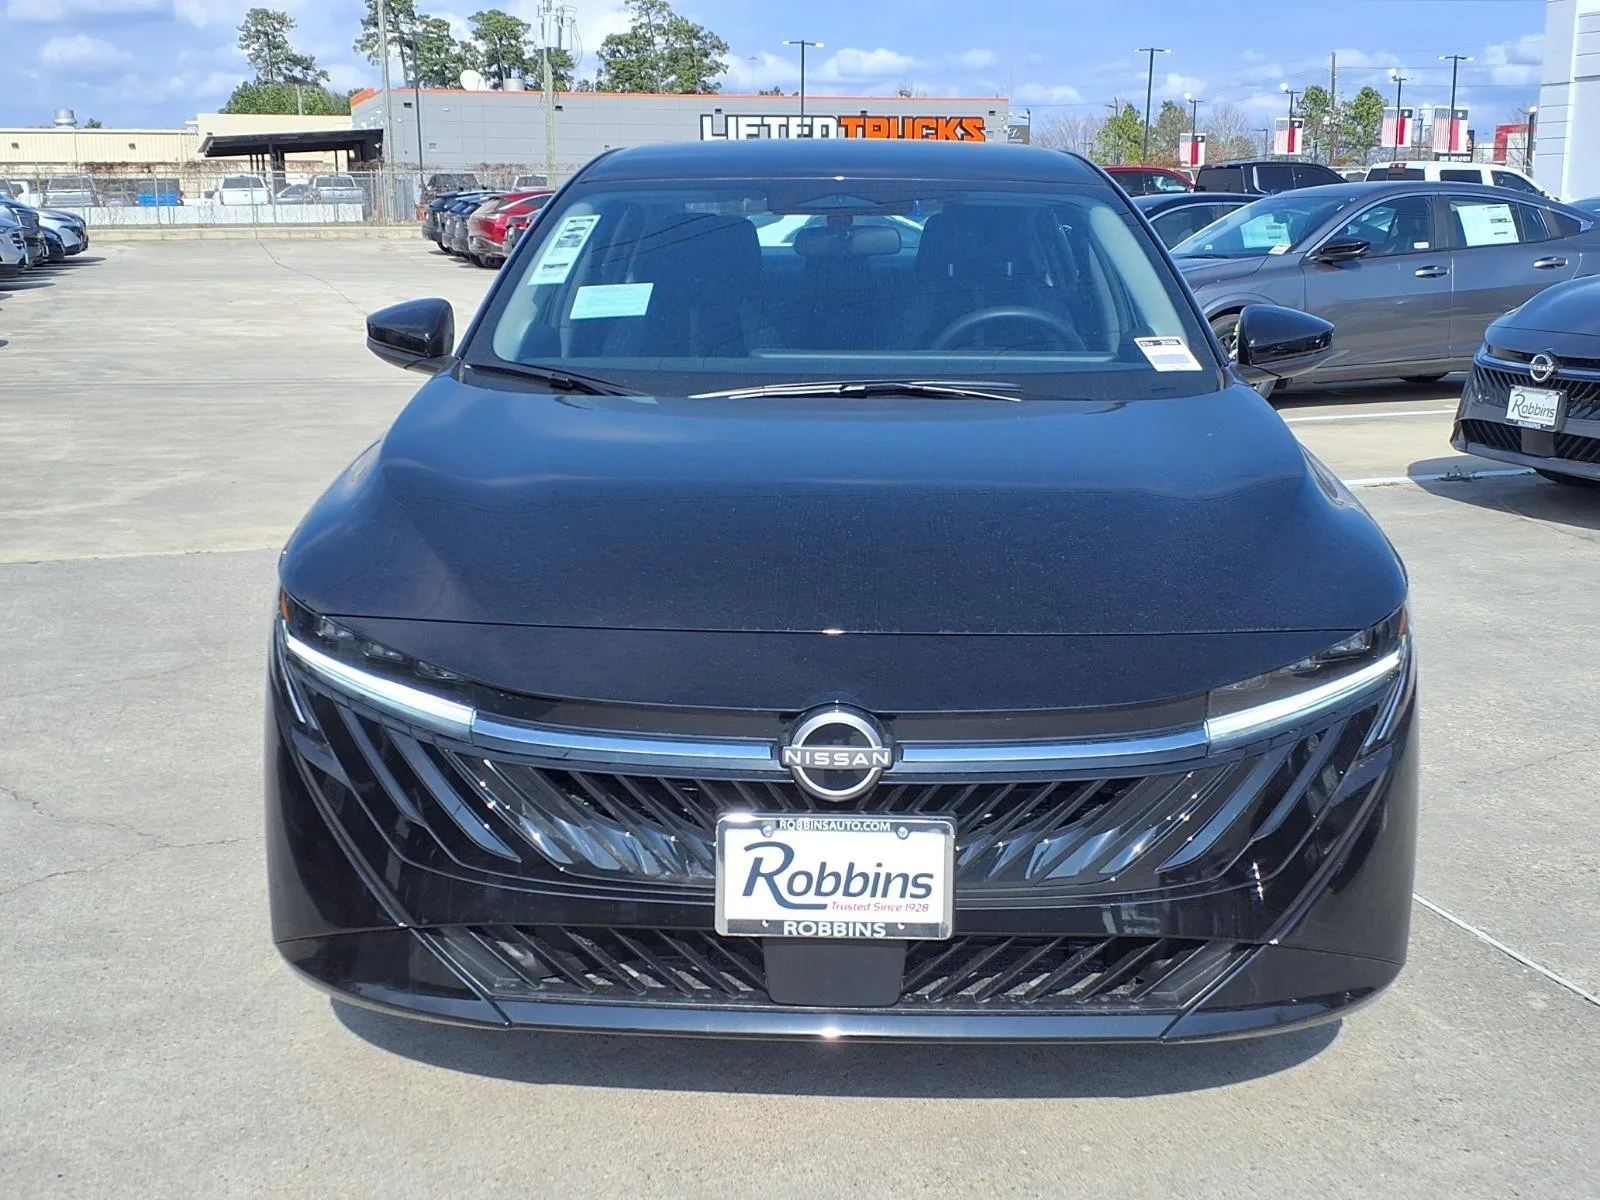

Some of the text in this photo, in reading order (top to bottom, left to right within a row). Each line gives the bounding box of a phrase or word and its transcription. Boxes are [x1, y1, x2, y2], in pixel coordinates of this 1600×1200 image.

[700, 114, 987, 142] LIFTED TRUCKS
[1511, 393, 1556, 419] Robbins
[784, 749, 890, 767] NISSAN
[779, 818, 891, 832] ROBBINSAUTO.COM
[742, 841, 934, 911] Robbins
[831, 901, 930, 913] Trusted Since 1928
[783, 920, 887, 938] ROBBINS
